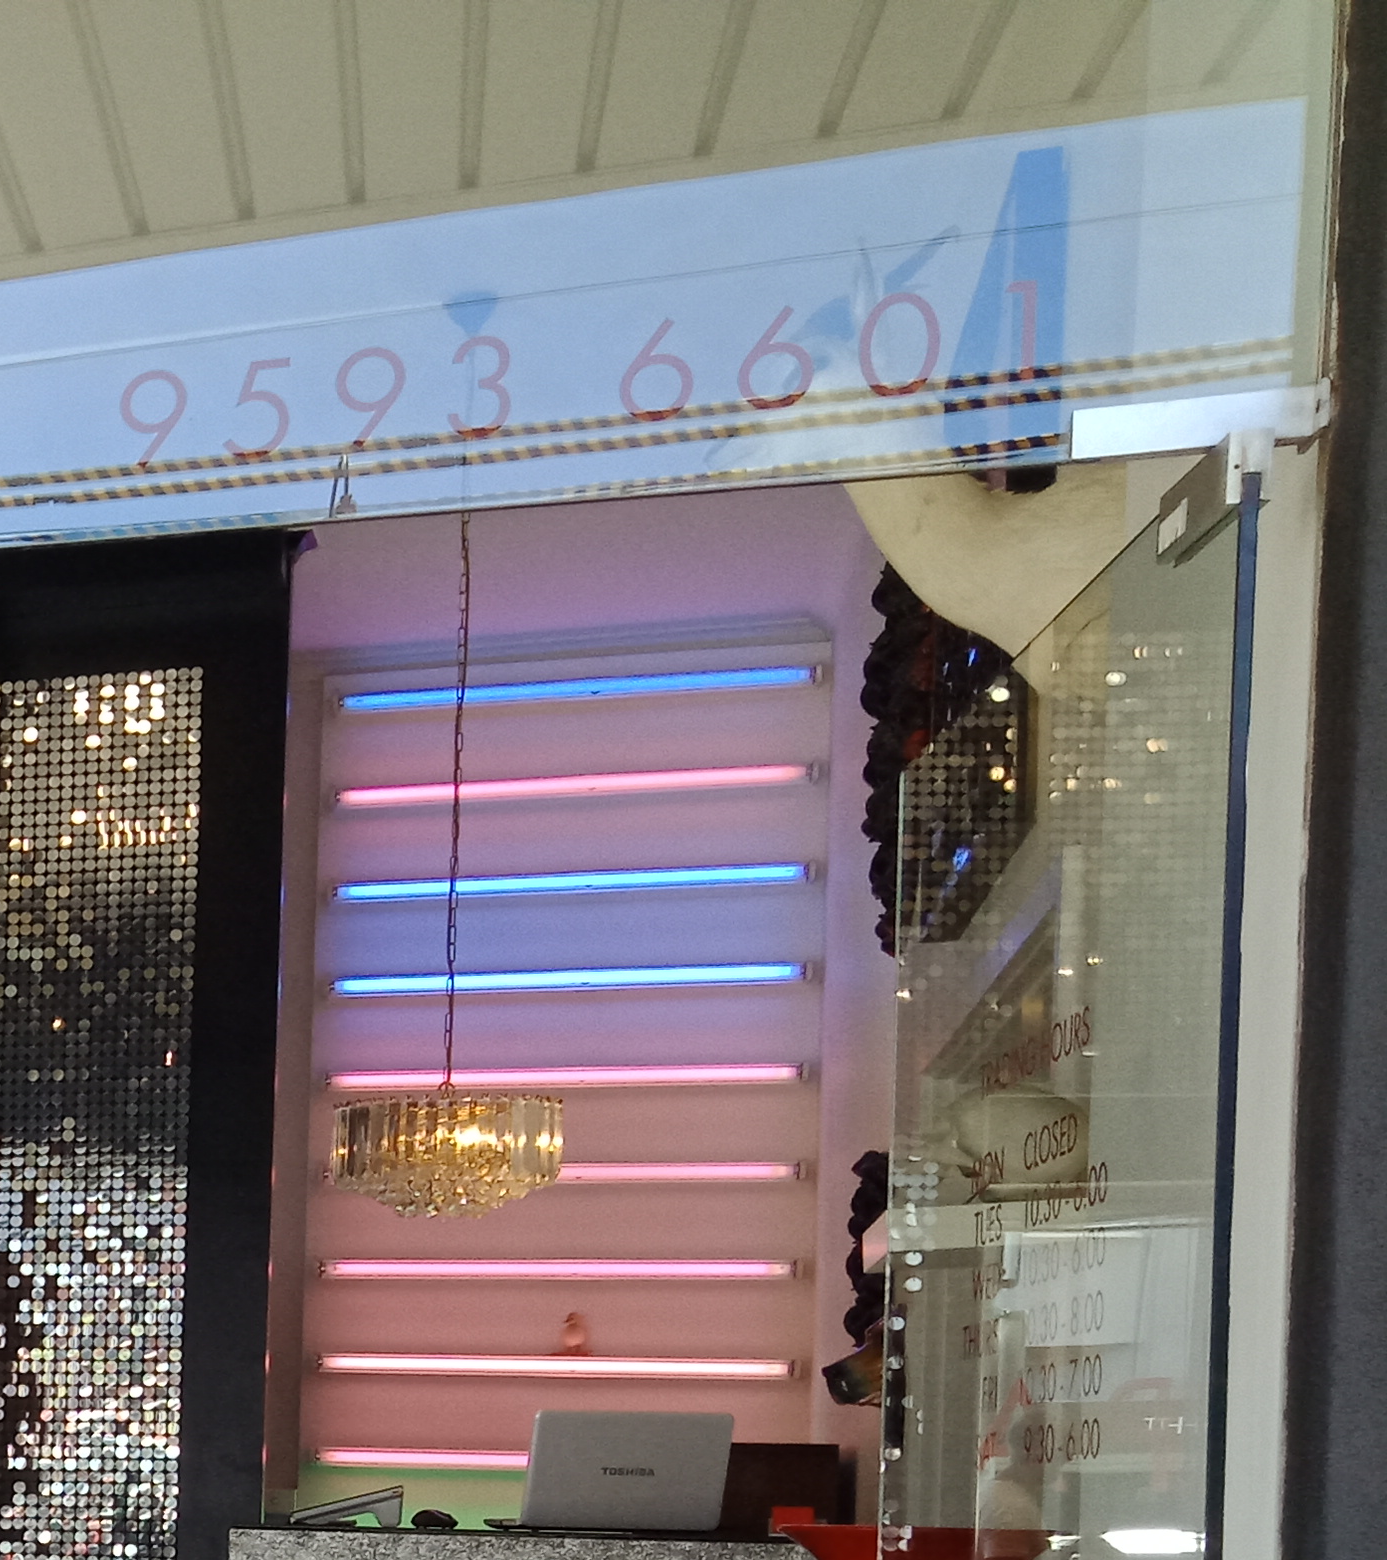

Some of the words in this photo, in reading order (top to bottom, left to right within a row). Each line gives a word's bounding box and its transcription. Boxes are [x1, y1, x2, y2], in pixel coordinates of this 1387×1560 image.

[120, 334, 513, 470] 9593
[616, 279, 1044, 425] 6601
[1023, 1112, 1078, 1171] CLOSED
[974, 1203, 1003, 1247] TUES
[600, 1467, 656, 1477] TOSHIBA
